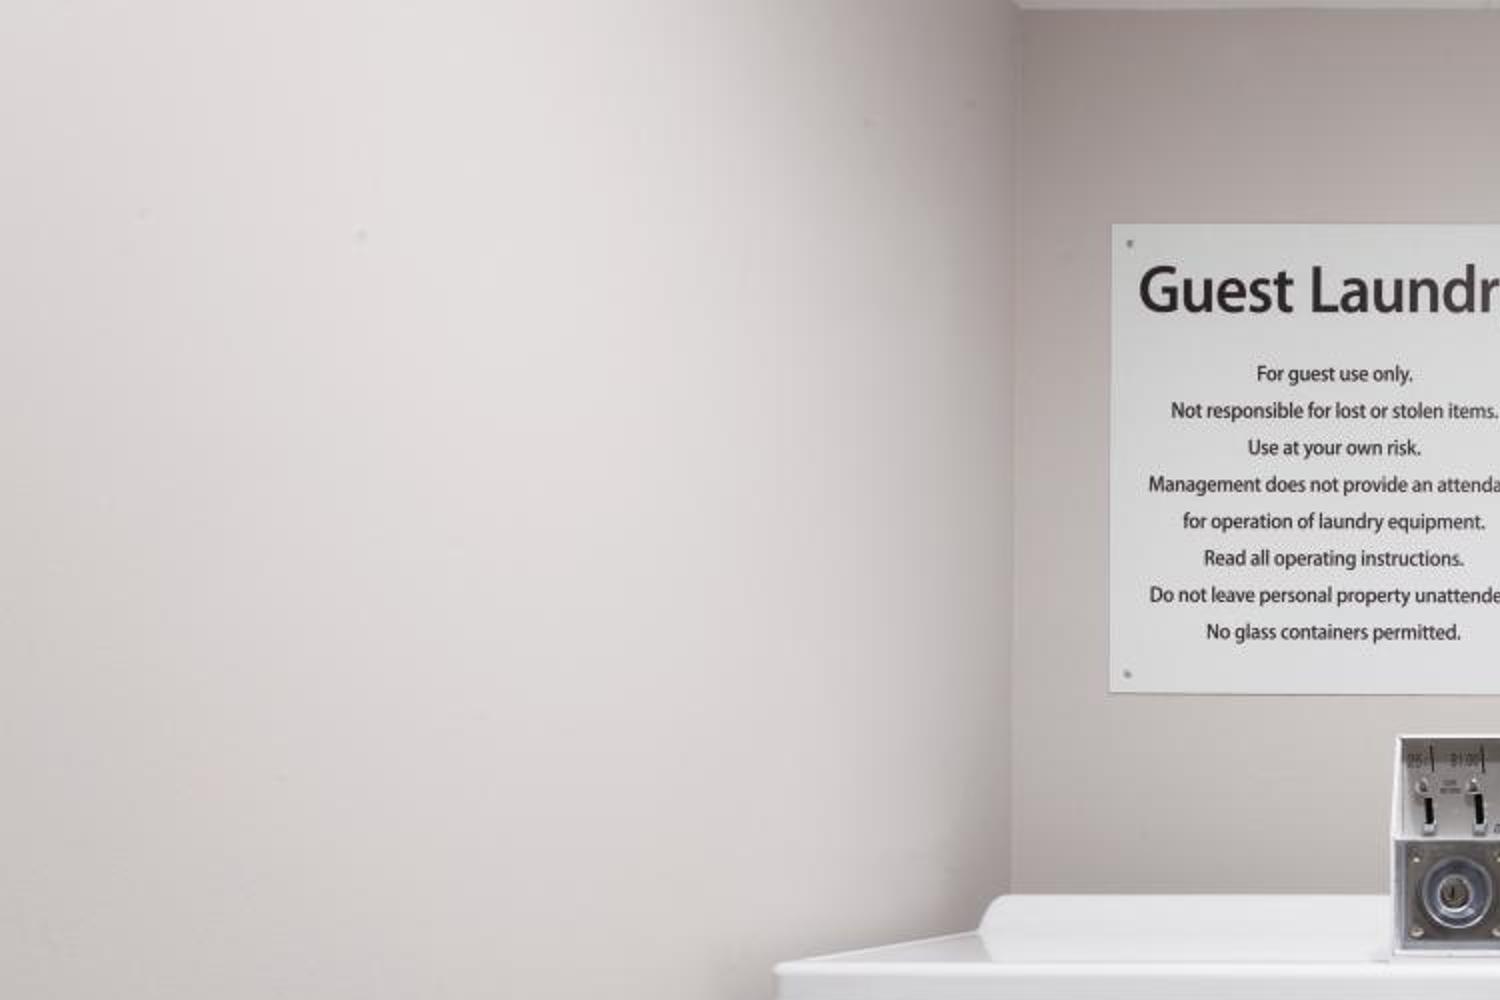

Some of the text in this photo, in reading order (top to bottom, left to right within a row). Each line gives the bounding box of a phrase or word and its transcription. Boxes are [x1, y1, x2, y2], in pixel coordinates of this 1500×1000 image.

[1139, 264, 1295, 315] Guest
[1256, 364, 1414, 387] For guest use only.
[1171, 400, 1499, 424] Not responsible for lost or stolen items.
[1247, 438, 1422, 461] Use at your own risk.
[1148, 474, 1262, 497] Management
[1265, 474, 1307, 493] does
[1309, 477, 1340, 493] not
[1343, 475, 1409, 497] provide
[1411, 479, 1433, 493] an
[1183, 511, 1486, 535] for operation of laundry equipment.
[1204, 548, 1465, 571] Read all operating instructions.
[1149, 585, 1175, 604] Do
[1178, 587, 1208, 604] not
[1211, 585, 1256, 604] leave
[1259, 585, 1333, 607] personal
[1336, 588, 1411, 609] property
[1206, 622, 1461, 645] No glass containers permitted.
